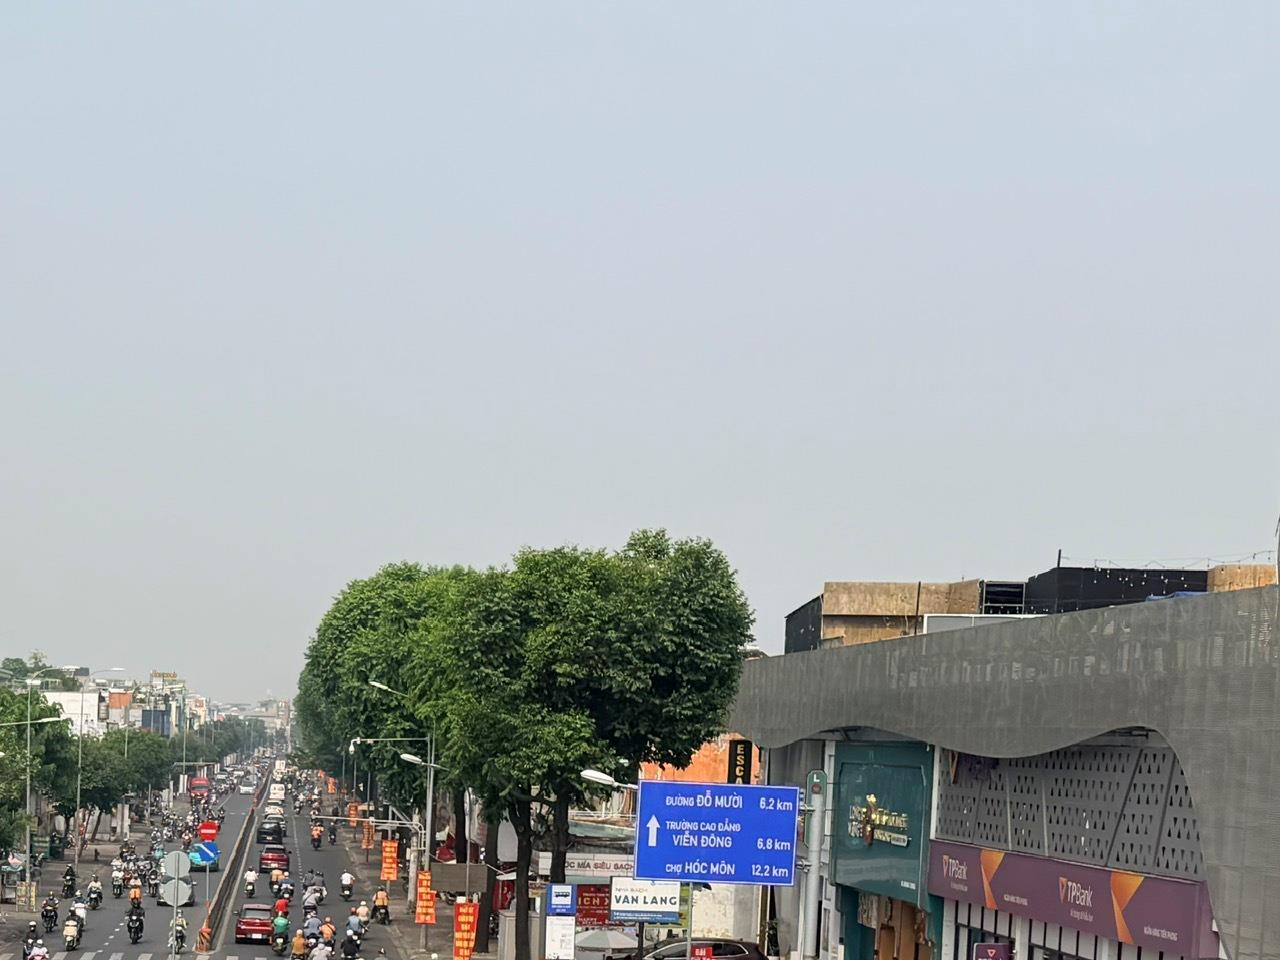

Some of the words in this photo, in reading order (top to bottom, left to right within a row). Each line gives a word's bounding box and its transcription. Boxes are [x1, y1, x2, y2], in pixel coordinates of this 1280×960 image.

[665, 796, 695, 807] ĐƯỜNG
[696, 790, 711, 808] ĐỖ
[715, 794, 743, 809] MƯỜI
[759, 797, 774, 810] 6.2
[777, 797, 793, 811] km
[665, 819, 699, 831] TRƯỜNG
[700, 822, 716, 832] CAO
[718, 818, 741, 832] ĐẲNG
[673, 831, 698, 847] VIỄN
[701, 833, 732, 848] ĐÔNG
[757, 838, 773, 850] 6.8
[775, 838, 791, 851] km
[665, 864, 683, 875] CHỢ
[685, 859, 707, 874] HÓC
[710, 861, 735, 875] MÔN
[752, 864, 769, 877] 12.2
[772, 864, 789, 877] km
[948, 858, 968, 880] TPBank
[643, 896, 677, 906] LANG
[1067, 881, 1093, 907] TPBank
